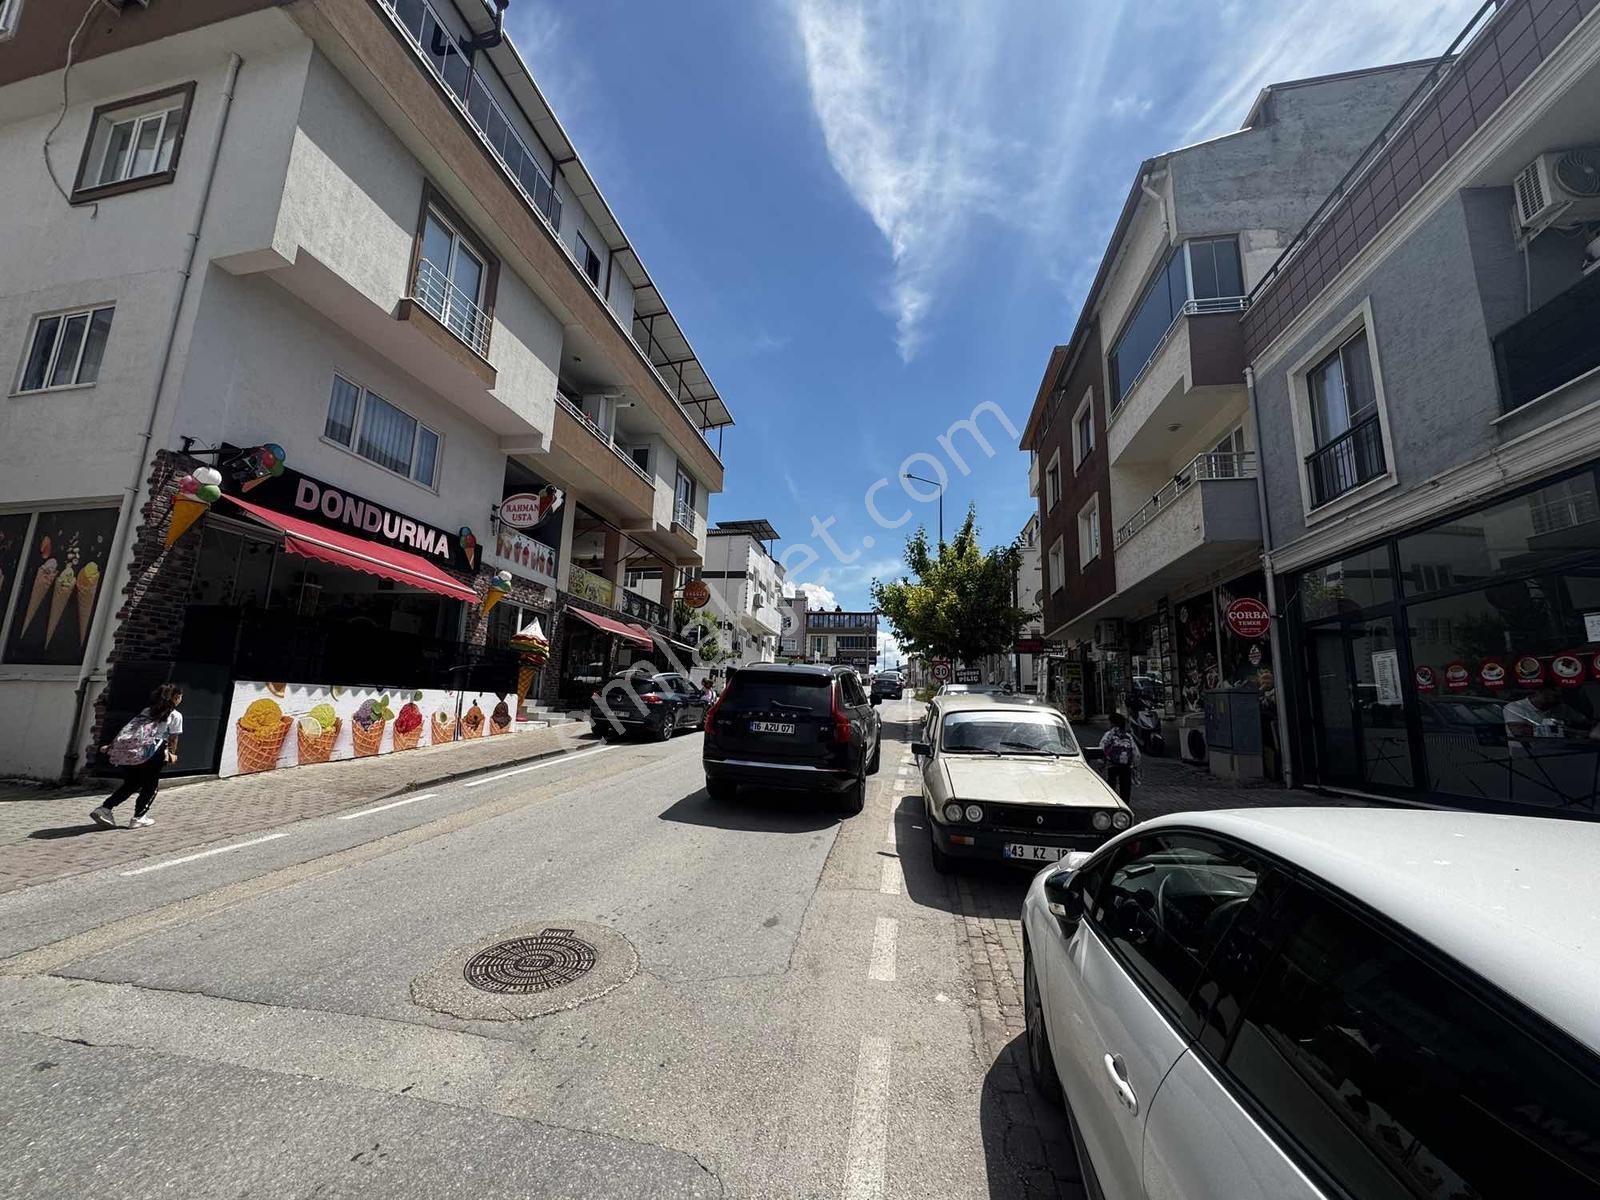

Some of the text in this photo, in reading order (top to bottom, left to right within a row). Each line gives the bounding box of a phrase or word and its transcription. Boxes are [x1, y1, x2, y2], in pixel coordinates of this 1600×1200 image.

[506, 504, 539, 513] RAHMAN
[294, 478, 451, 559] DONDURMA
[511, 513, 532, 521] USTA
[1229, 611, 1268, 622] ÇORBA
[936, 667, 946, 676] 30
[754, 722, 794, 733] 16 AZU 071
[1011, 845, 1024, 857] 43
[1033, 847, 1046, 859] KZ
